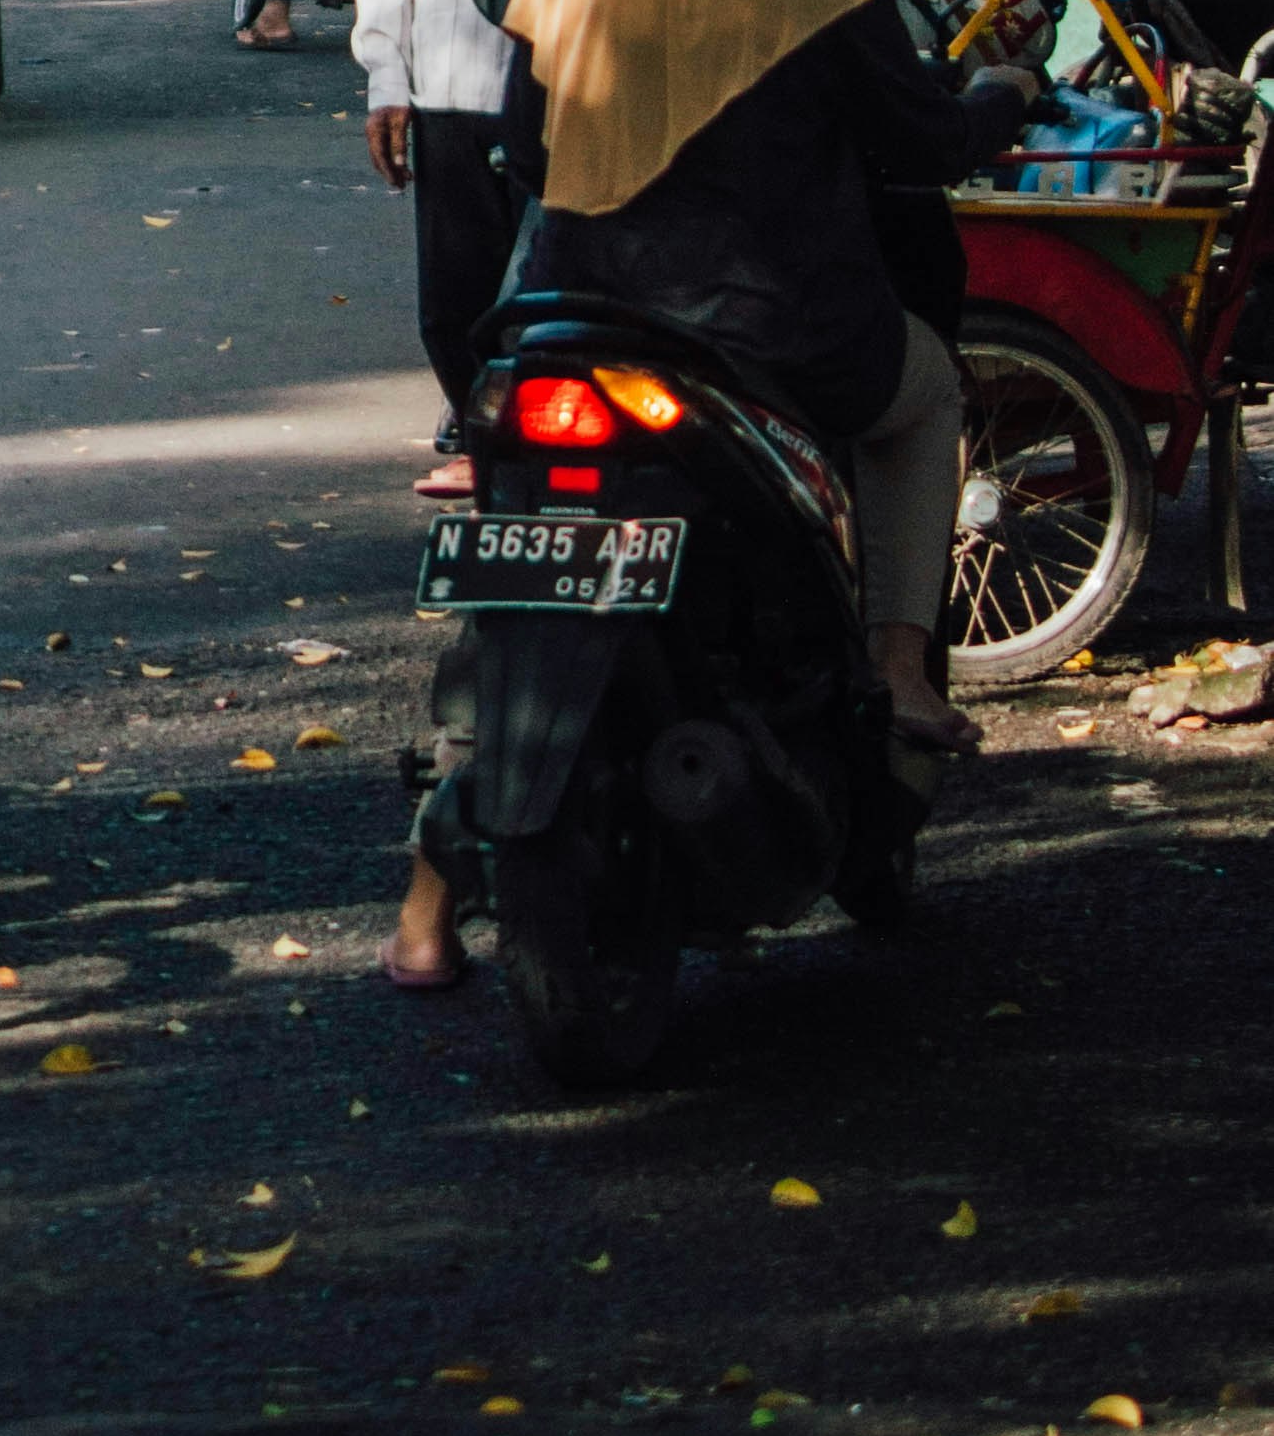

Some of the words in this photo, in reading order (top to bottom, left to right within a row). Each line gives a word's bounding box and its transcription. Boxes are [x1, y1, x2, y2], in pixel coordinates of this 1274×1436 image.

[437, 525, 462, 559] N
[477, 524, 576, 562] 5635
[596, 526, 673, 562] ABR
